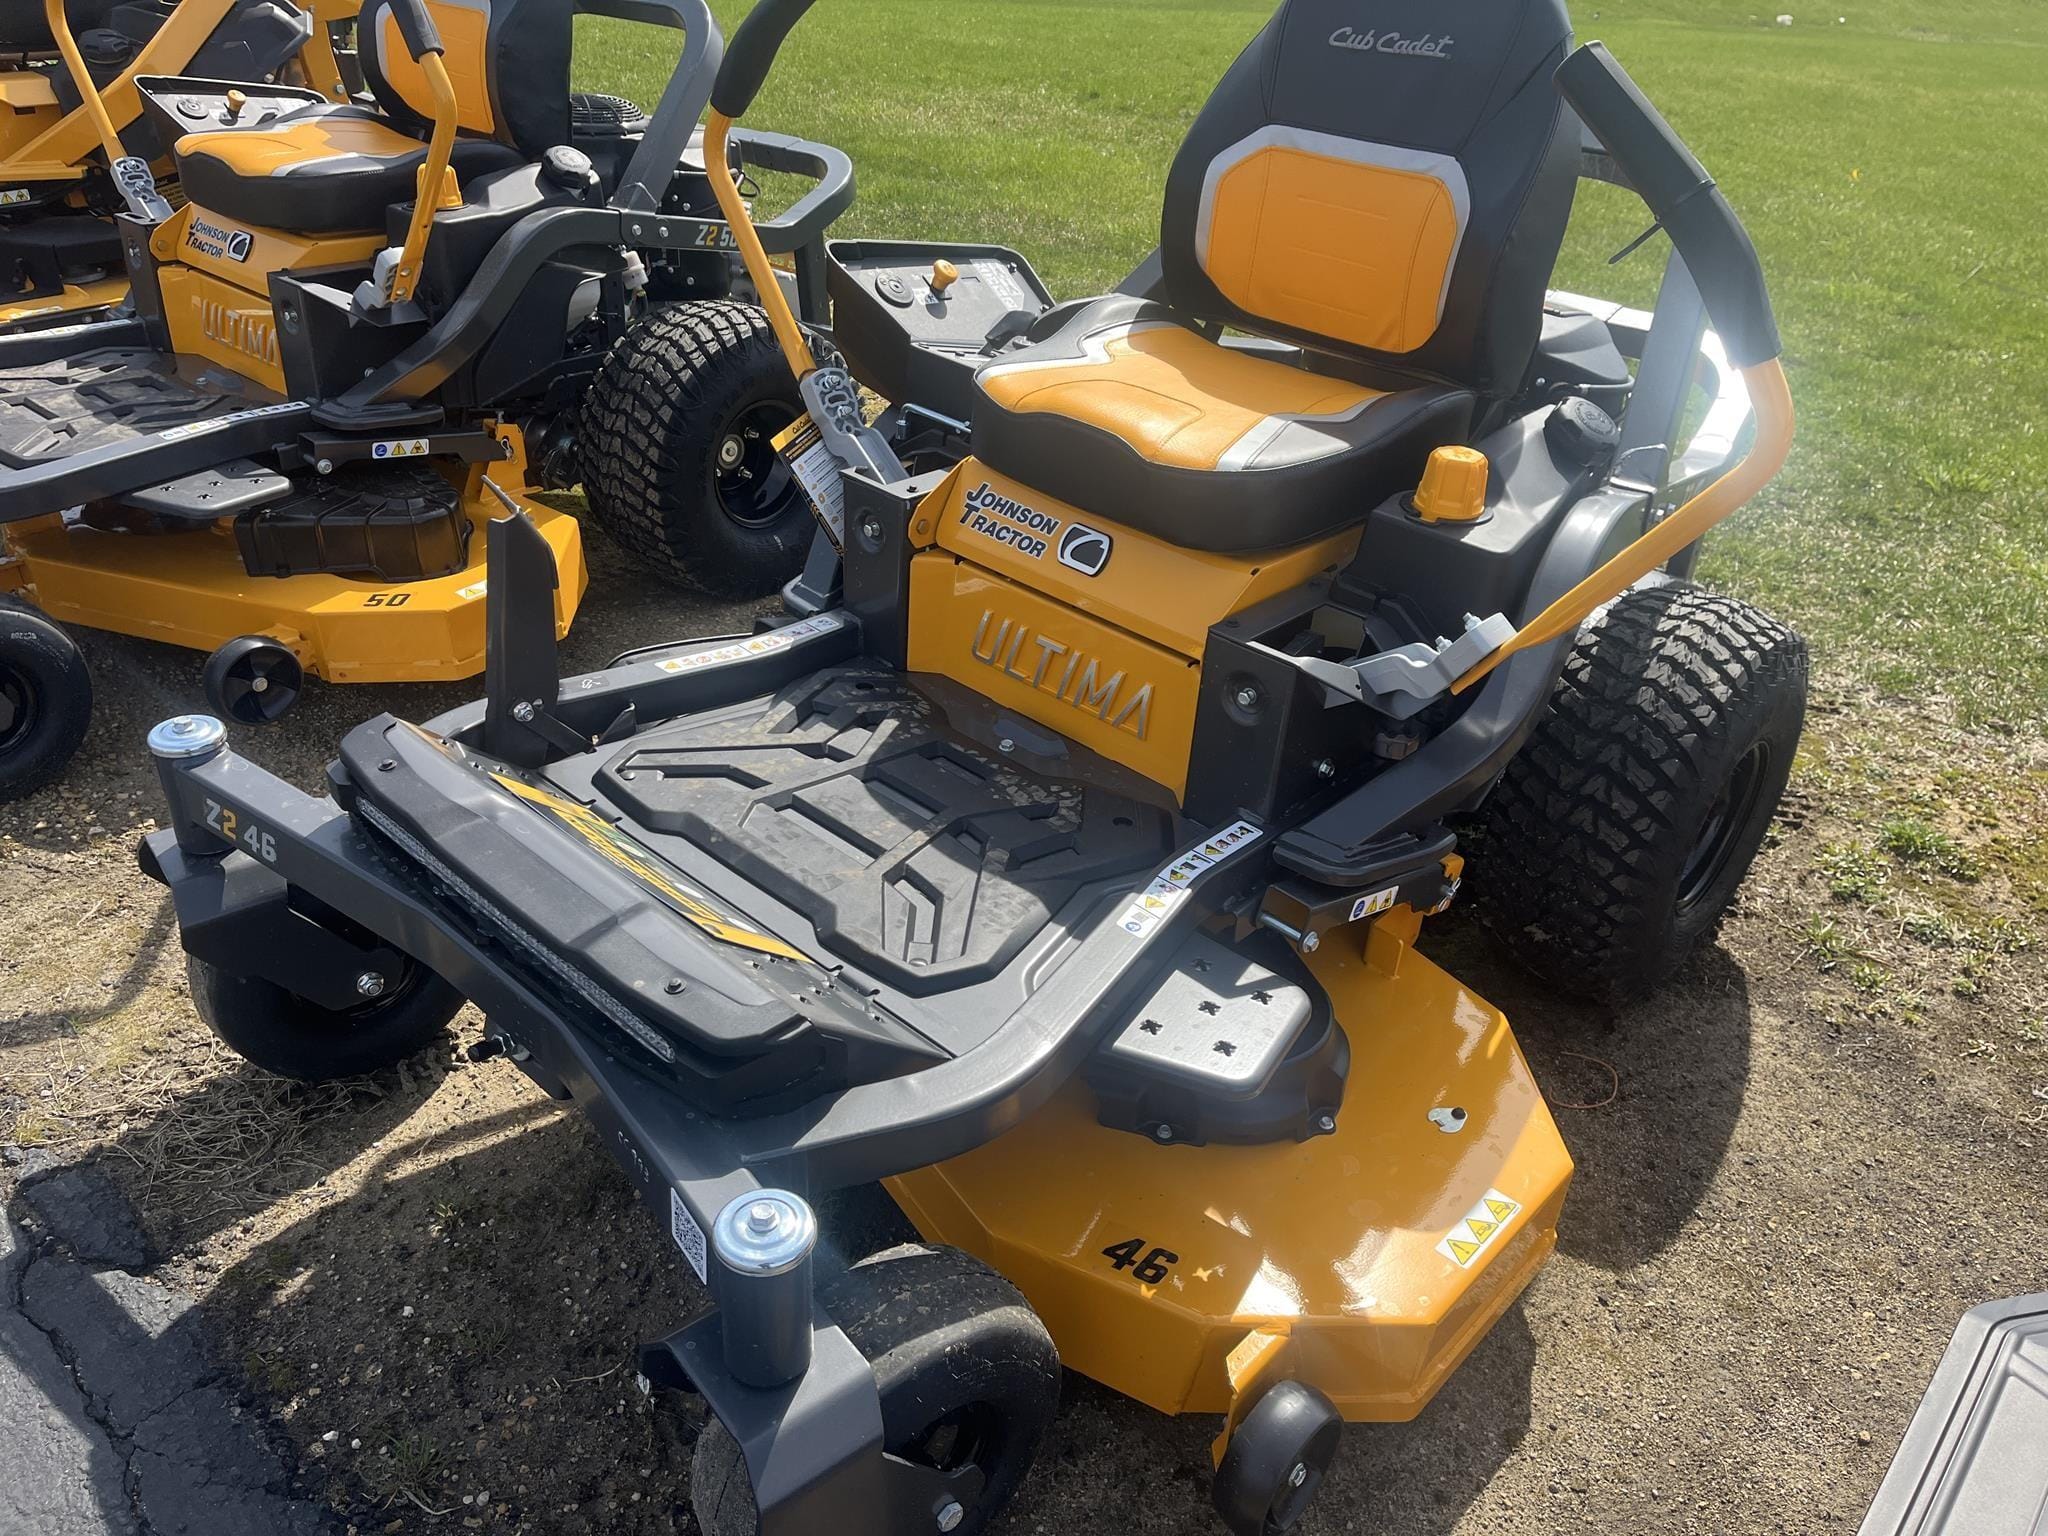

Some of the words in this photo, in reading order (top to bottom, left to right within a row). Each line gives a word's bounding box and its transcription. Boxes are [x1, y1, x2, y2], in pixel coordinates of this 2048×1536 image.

[1328, 26, 1375, 50] Cub
[1376, 31, 1454, 58] Cadet
[695, 224, 718, 247] Z2
[201, 299, 279, 367] ULTIMA
[959, 502, 1047, 559] TRACTOR
[966, 483, 1060, 536] JOHNSON
[363, 593, 411, 606] 50
[972, 608, 1154, 741] ULTIMA
[206, 798, 236, 840] Z2
[243, 825, 277, 863] 46
[1102, 1238, 1178, 1284] 46
